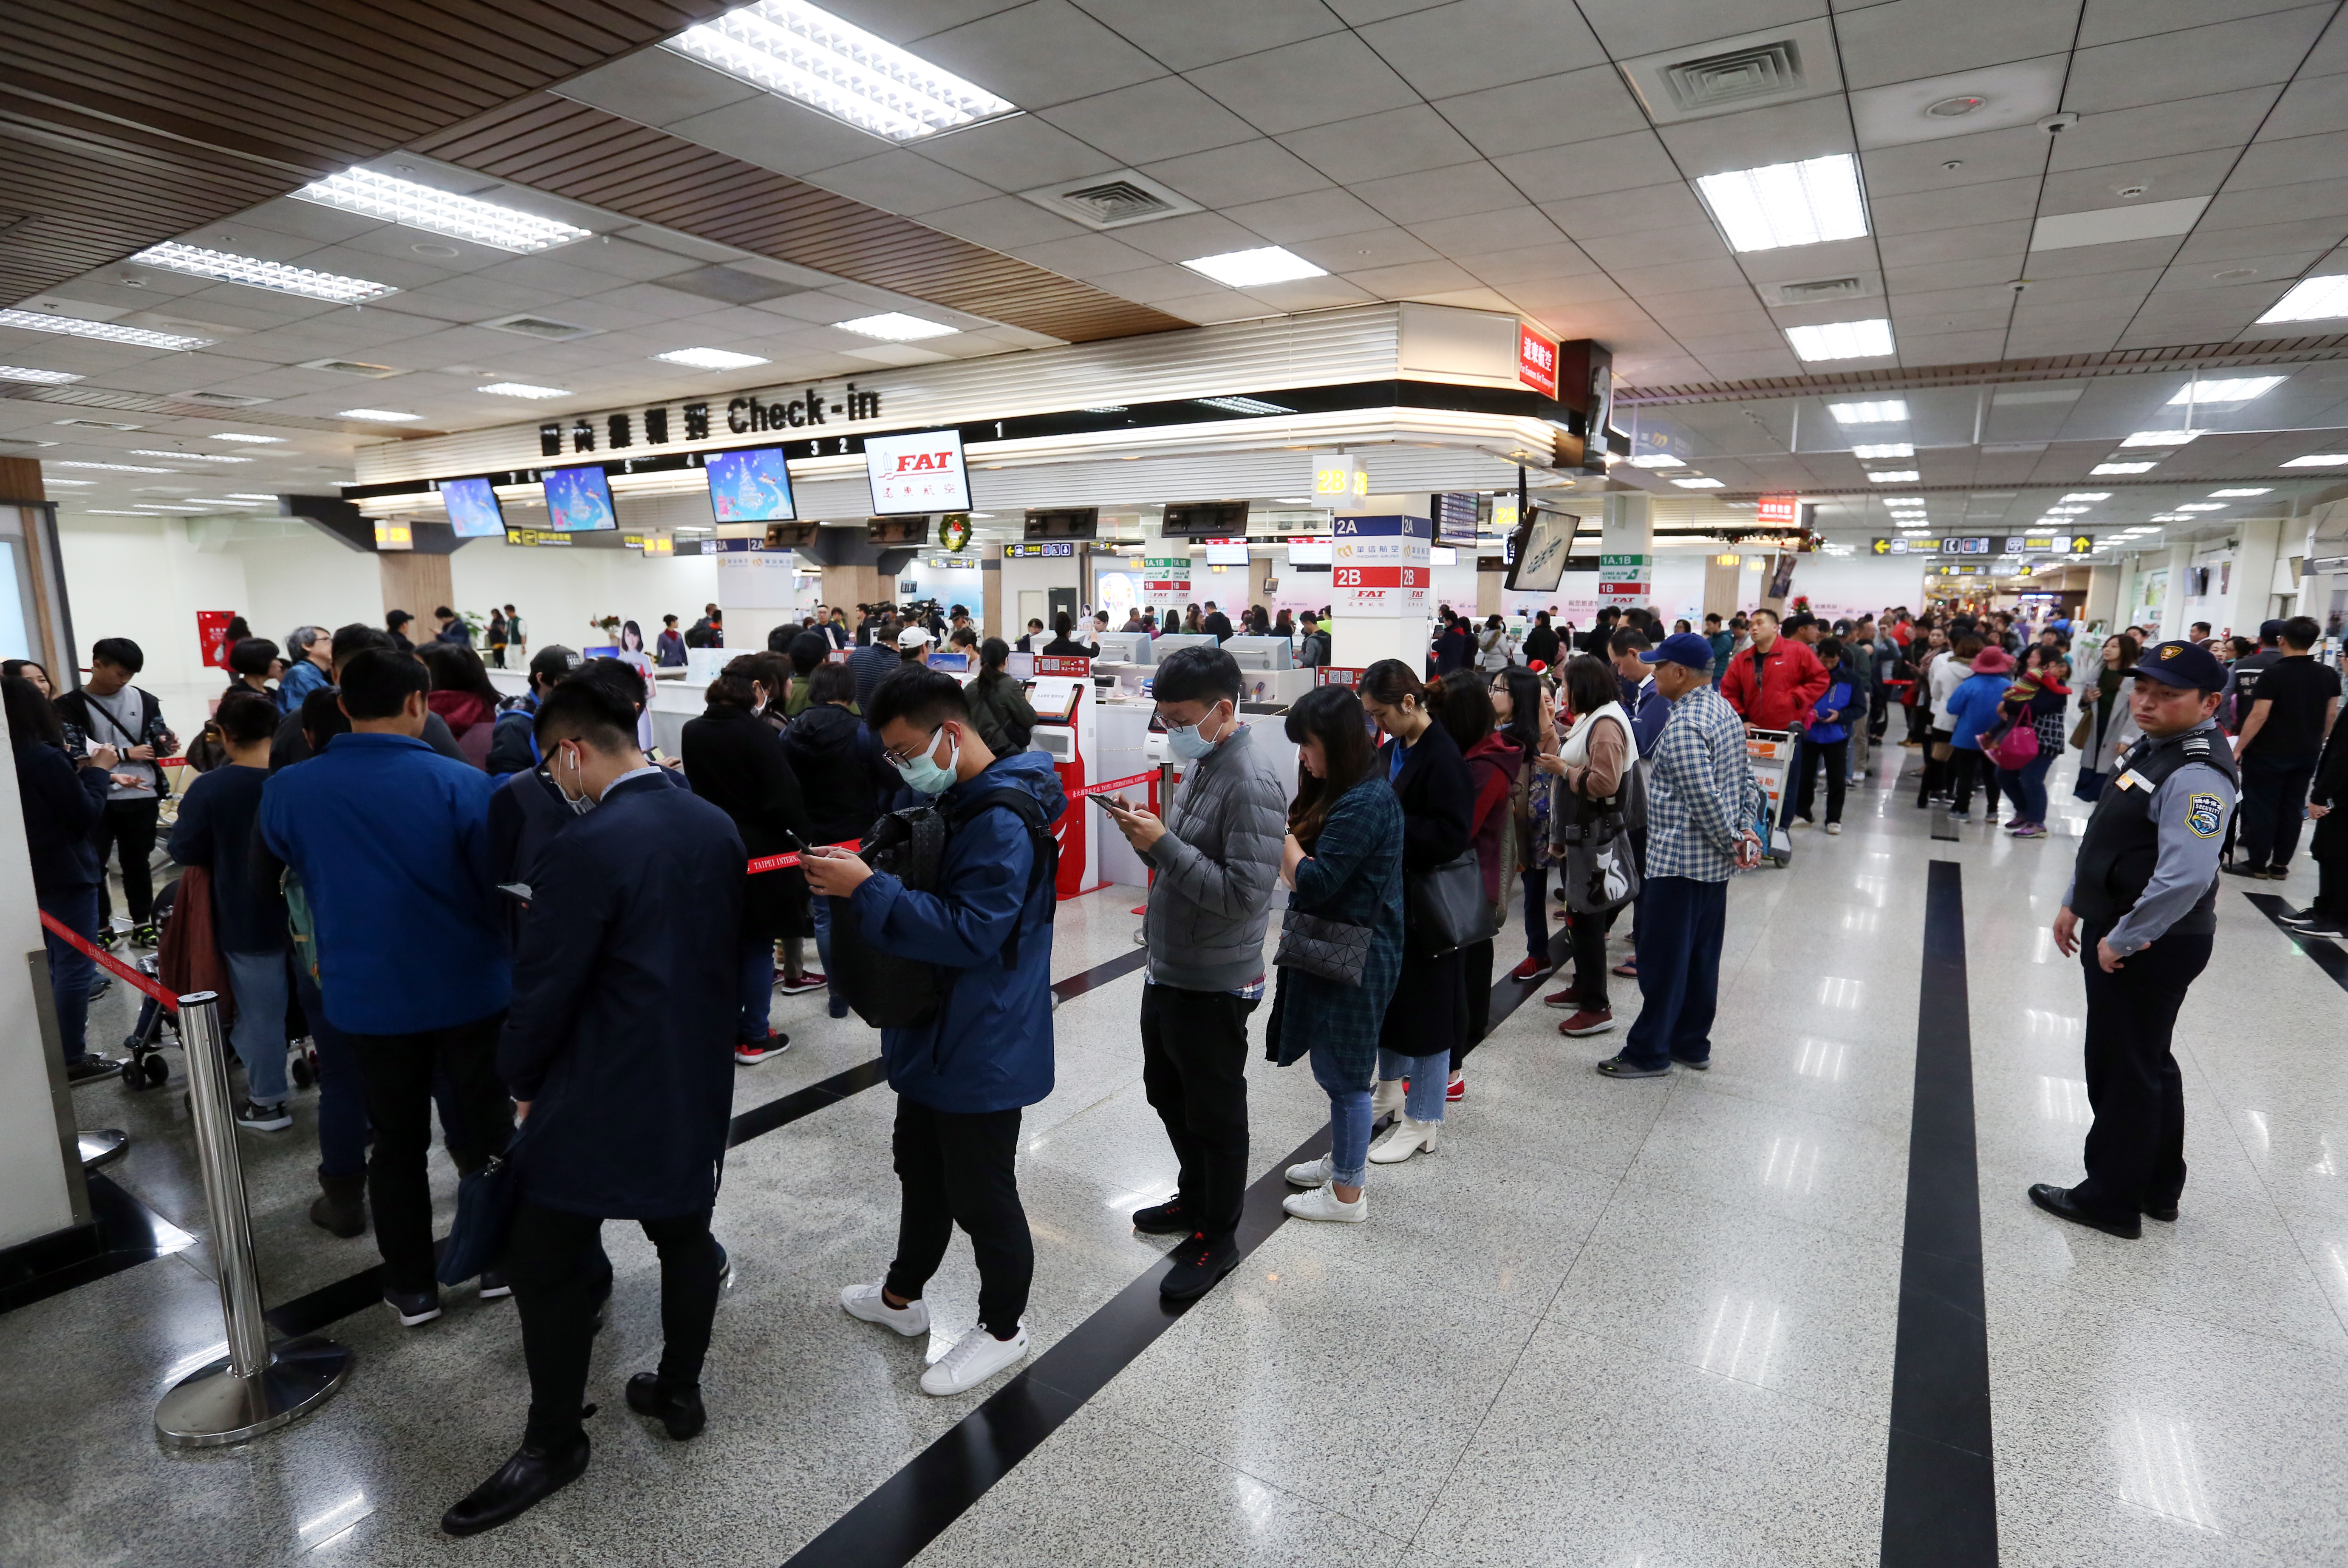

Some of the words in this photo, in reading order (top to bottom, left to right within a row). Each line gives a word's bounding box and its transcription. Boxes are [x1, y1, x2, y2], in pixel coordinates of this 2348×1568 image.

[1523, 336, 1552, 372] 遠東航空
[995, 421, 1004, 438] 1
[810, 440, 820, 456] 3
[839, 437, 848, 453] 2
[625, 459, 634, 473] 5
[686, 453, 695, 467] 4
[896, 451, 953, 472] FAT
[1317, 470, 1346, 494] 2B
[1495, 507, 1518, 524] 2A
[1337, 519, 1358, 534] 2A
[1404, 518, 1414, 534] 2A
[717, 540, 728, 551] 2A
[751, 540, 764, 550] 2A
[1338, 569, 1361, 585] 2B
[1403, 569, 1414, 586] 2B
[1601, 584, 1614, 593] 1B
[1112, 778, 1134, 788] INTERNATIONAL
[2195, 804, 2220, 815] SECURITY
[753, 859, 775, 869] TAIPEI
[776, 855, 800, 866] INTERNA
